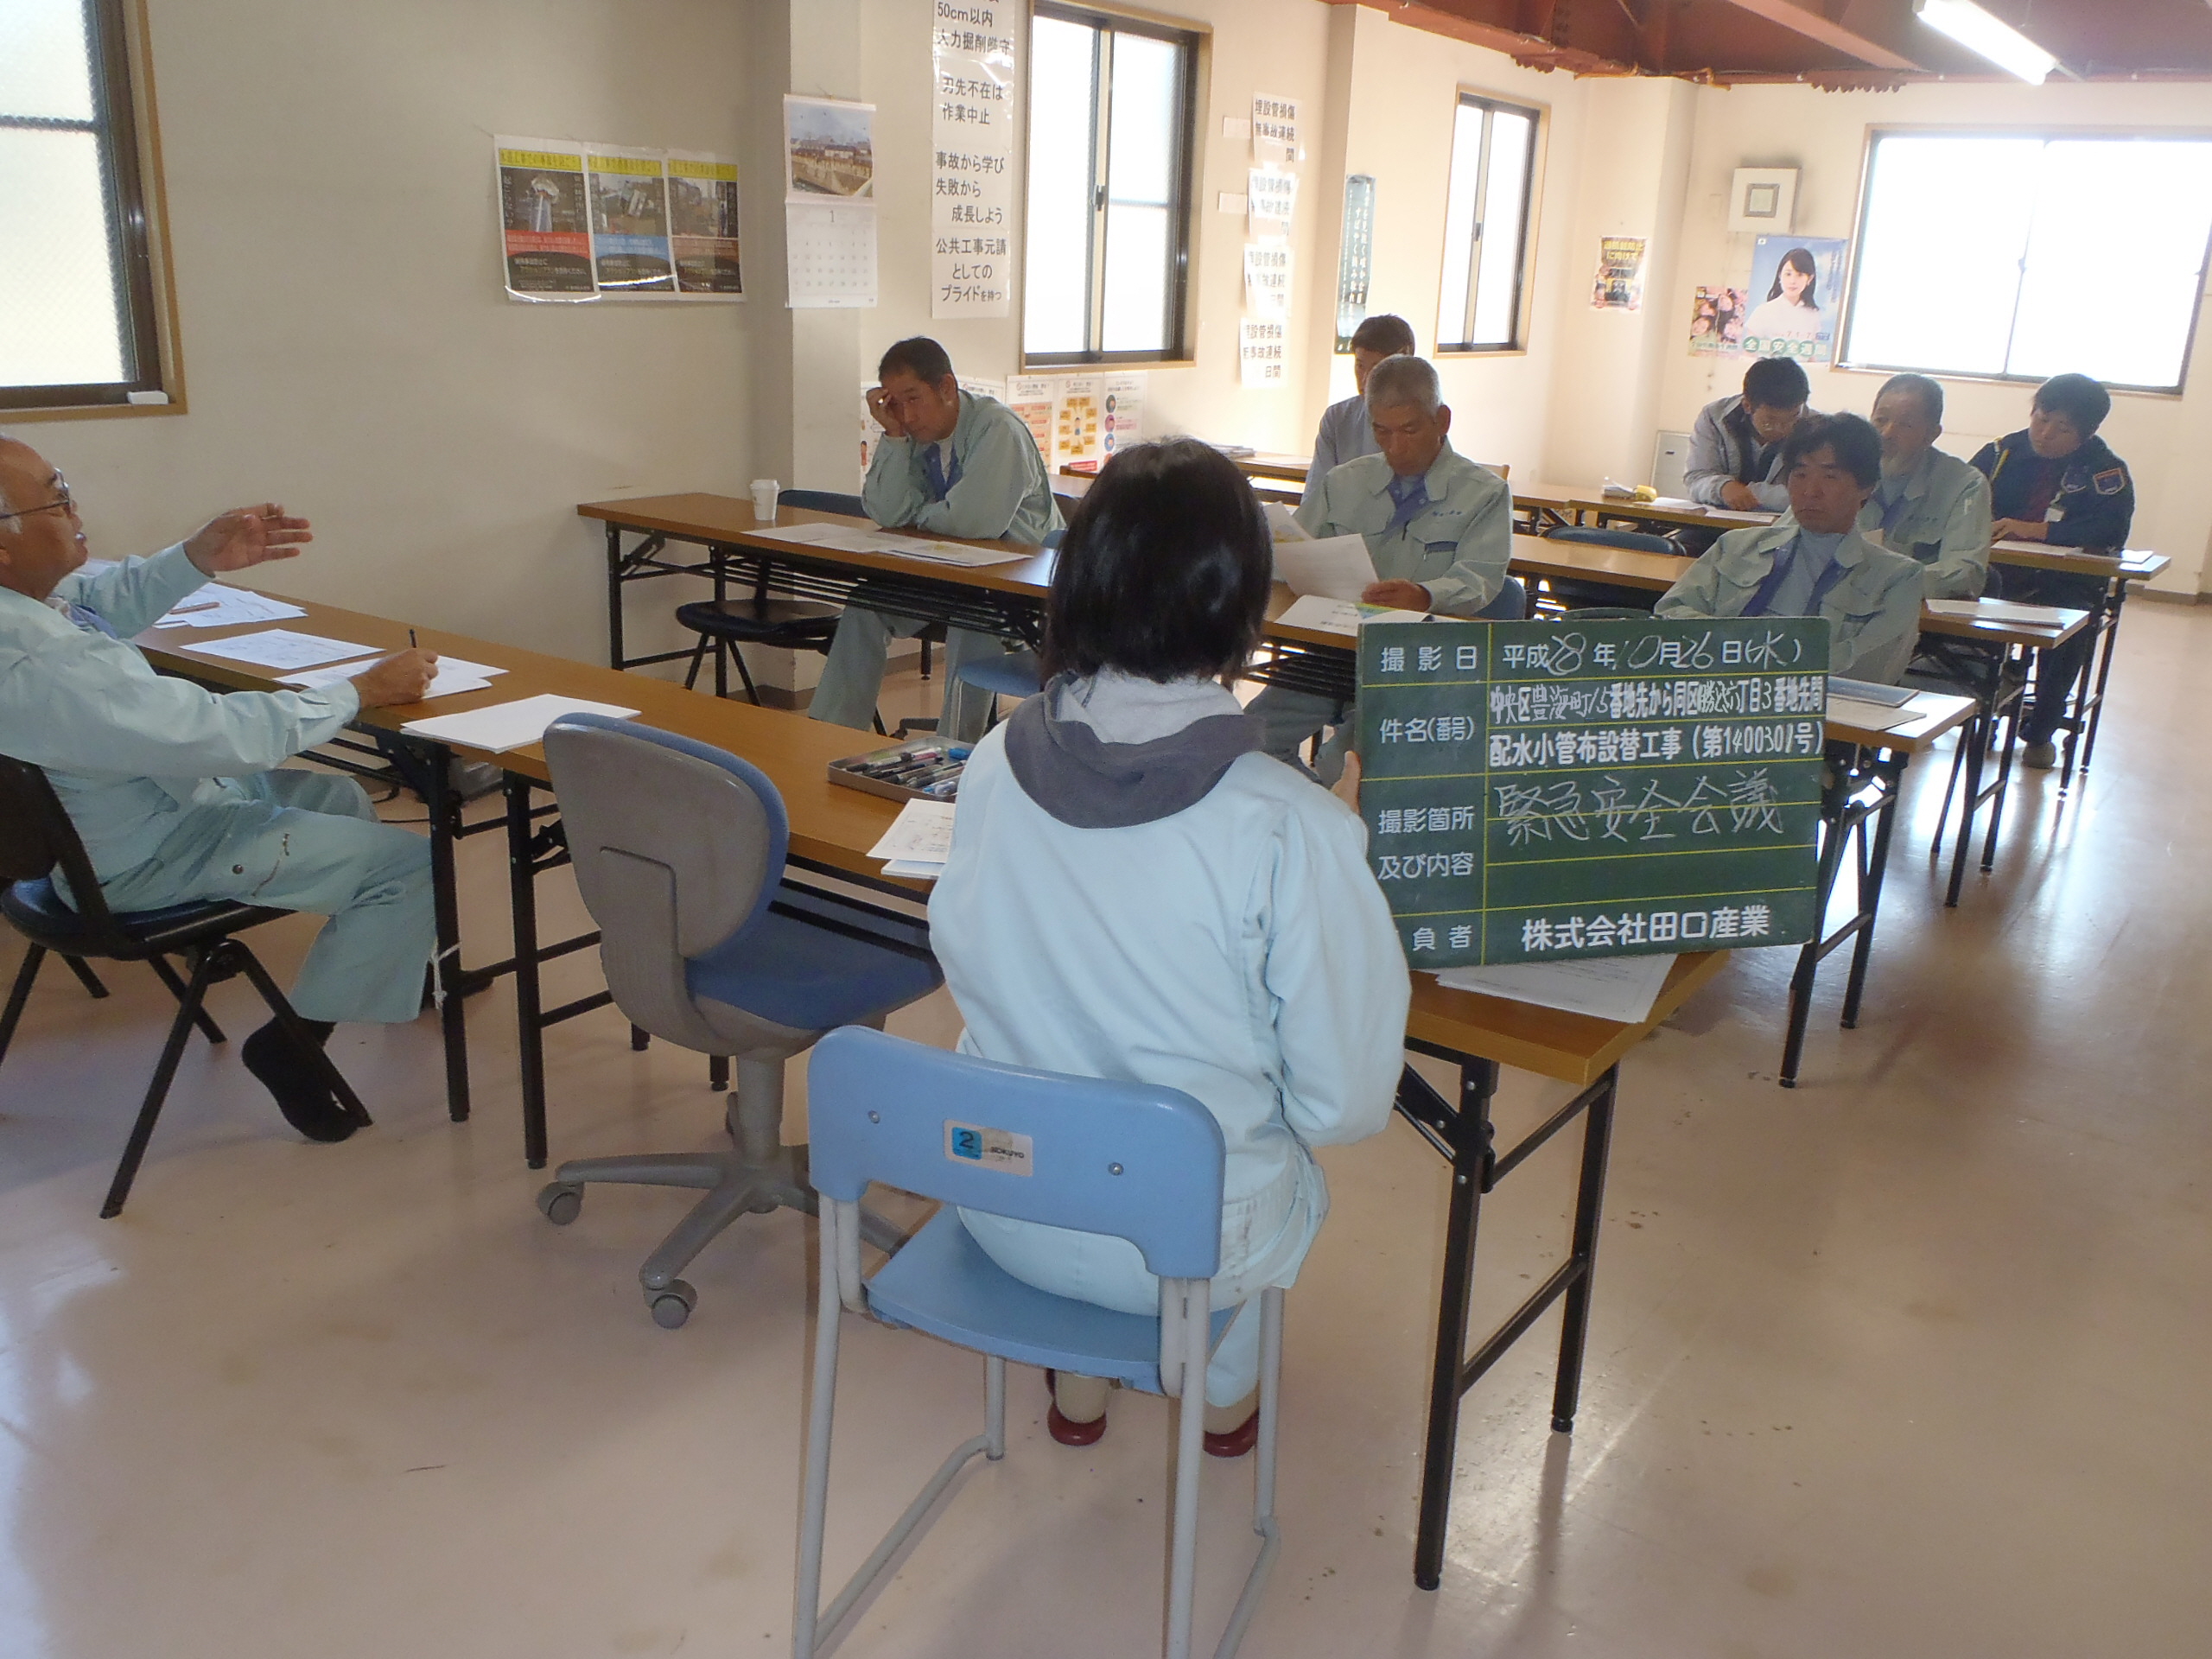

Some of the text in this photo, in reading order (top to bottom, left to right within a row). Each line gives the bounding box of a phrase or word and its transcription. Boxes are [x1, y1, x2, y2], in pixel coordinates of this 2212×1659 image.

[938, 2, 994, 28] 50cm以内
[943, 102, 991, 126] 作業中止
[1255, 99, 1295, 121] 埋設管損傷
[1255, 122, 1294, 143] 無事故連続
[936, 151, 1004, 174] 事故から学び
[936, 177, 982, 198] 失敗から
[951, 205, 1003, 225] 成長しよう
[936, 238, 1007, 256] 公共工事元請
[952, 263, 993, 280] としての
[941, 284, 1002, 302] プライドを持つ
[1380, 645, 1478, 671] 撮影日
[1379, 716, 1475, 744] 件名(番号)
[1495, 766, 1783, 847] 緊急安全会議
[1377, 804, 1475, 833] 撮影箇所
[1377, 851, 1475, 880] 及び内容
[1412, 925, 1473, 952] 負者
[1521, 905, 1771, 952] 株式会社田口産業
[958, 1131, 975, 1149] 2
